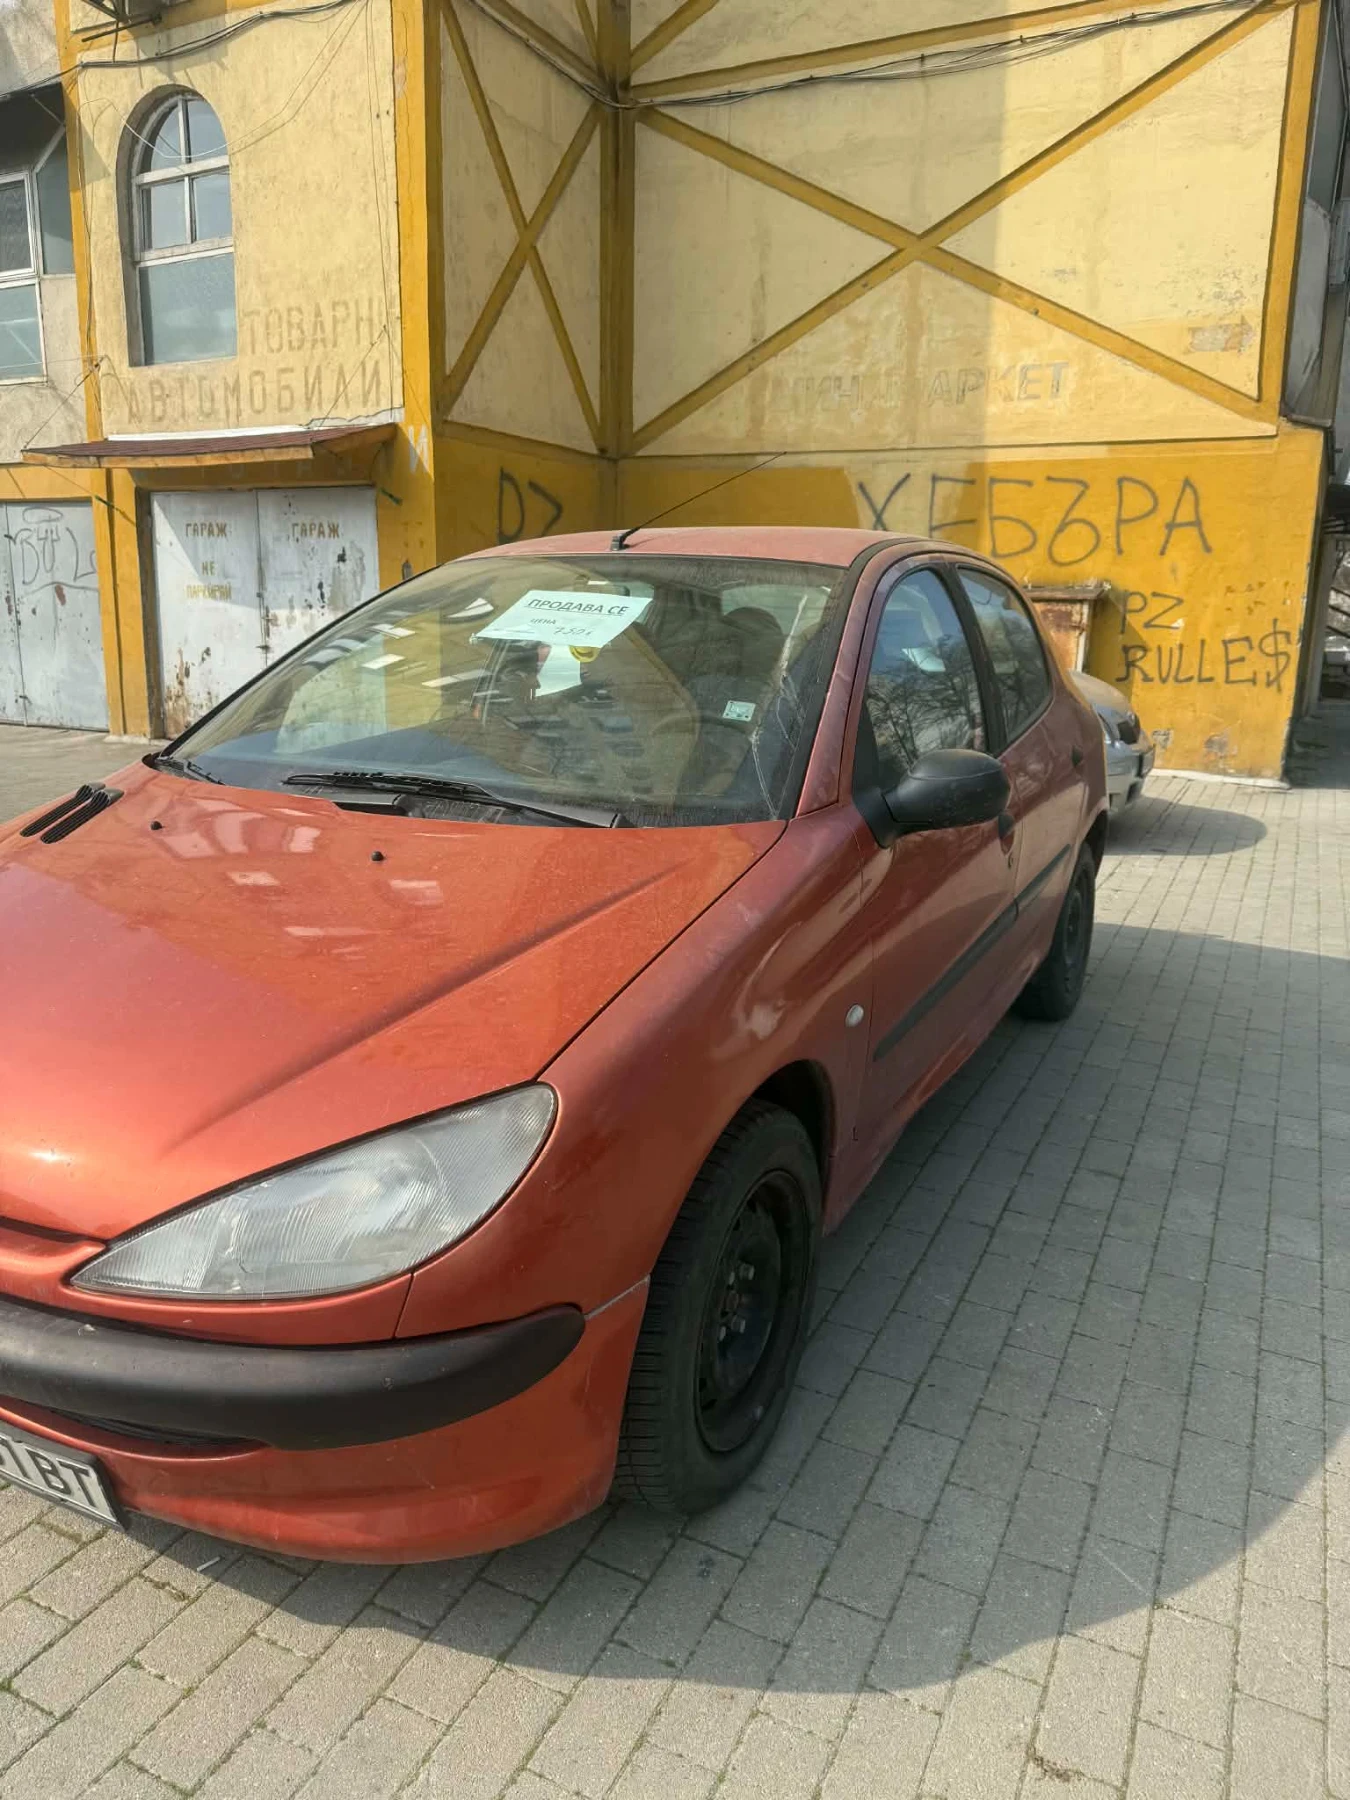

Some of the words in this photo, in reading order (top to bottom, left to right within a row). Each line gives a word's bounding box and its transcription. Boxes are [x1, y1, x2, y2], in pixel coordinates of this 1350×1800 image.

[127, 359, 382, 427] АВТОМОБИЛИ
[185, 522, 228, 538] ГАРАЖ
[292, 521, 340, 539] ГАРАЖ
[201, 561, 216, 576] НЕ
[527, 598, 603, 614] ПРОДАВА
[607, 605, 630, 615] СЕ
[1119, 589, 1184, 635] PZ
